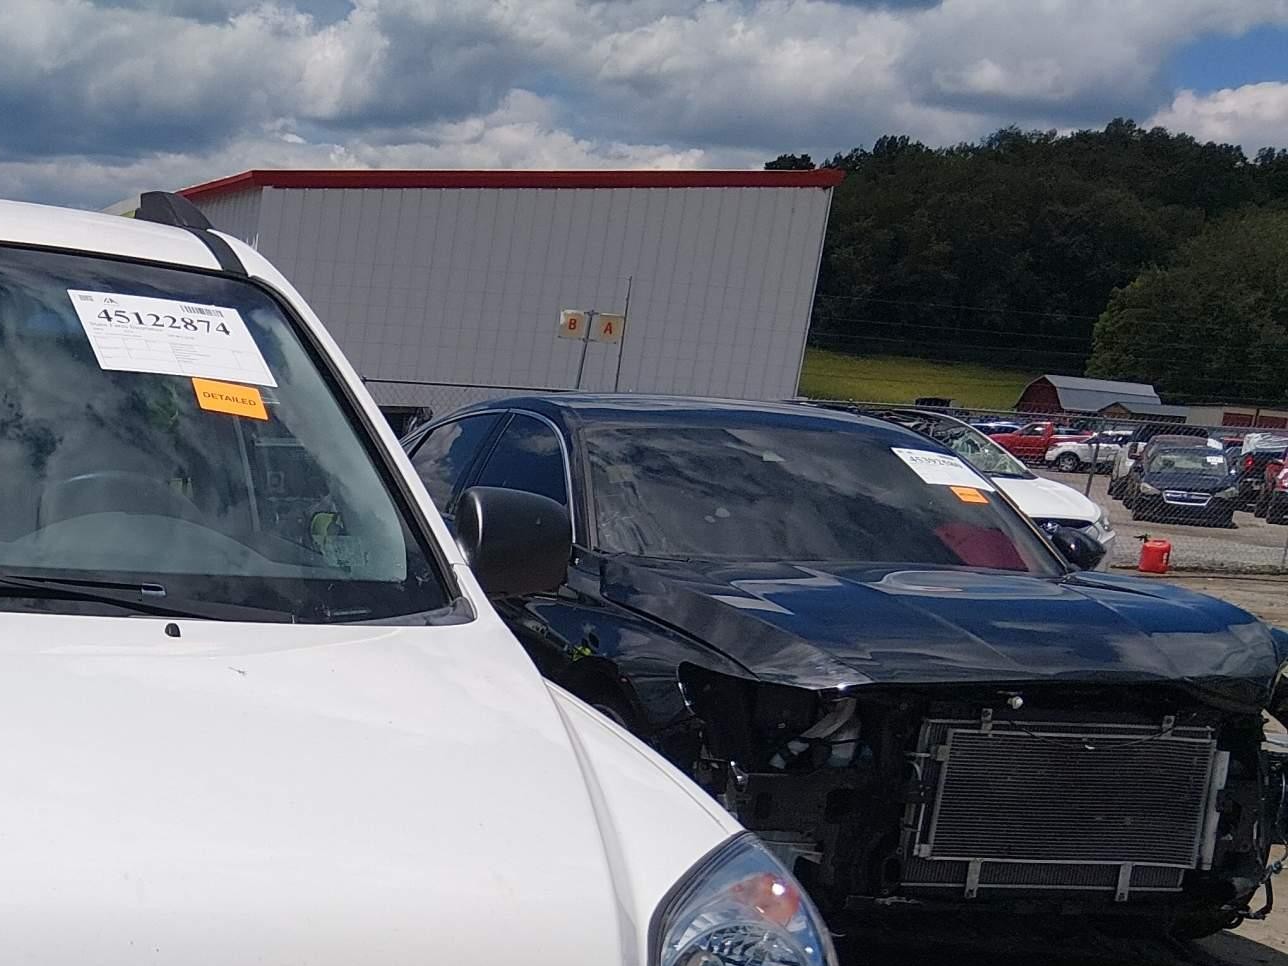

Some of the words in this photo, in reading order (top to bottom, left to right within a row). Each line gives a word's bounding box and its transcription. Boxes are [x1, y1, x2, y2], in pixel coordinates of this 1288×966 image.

[97, 308, 231, 336] 45122874
[568, 318, 577, 330] B
[603, 322, 613, 335] A
[202, 391, 257, 407] DETAILED
